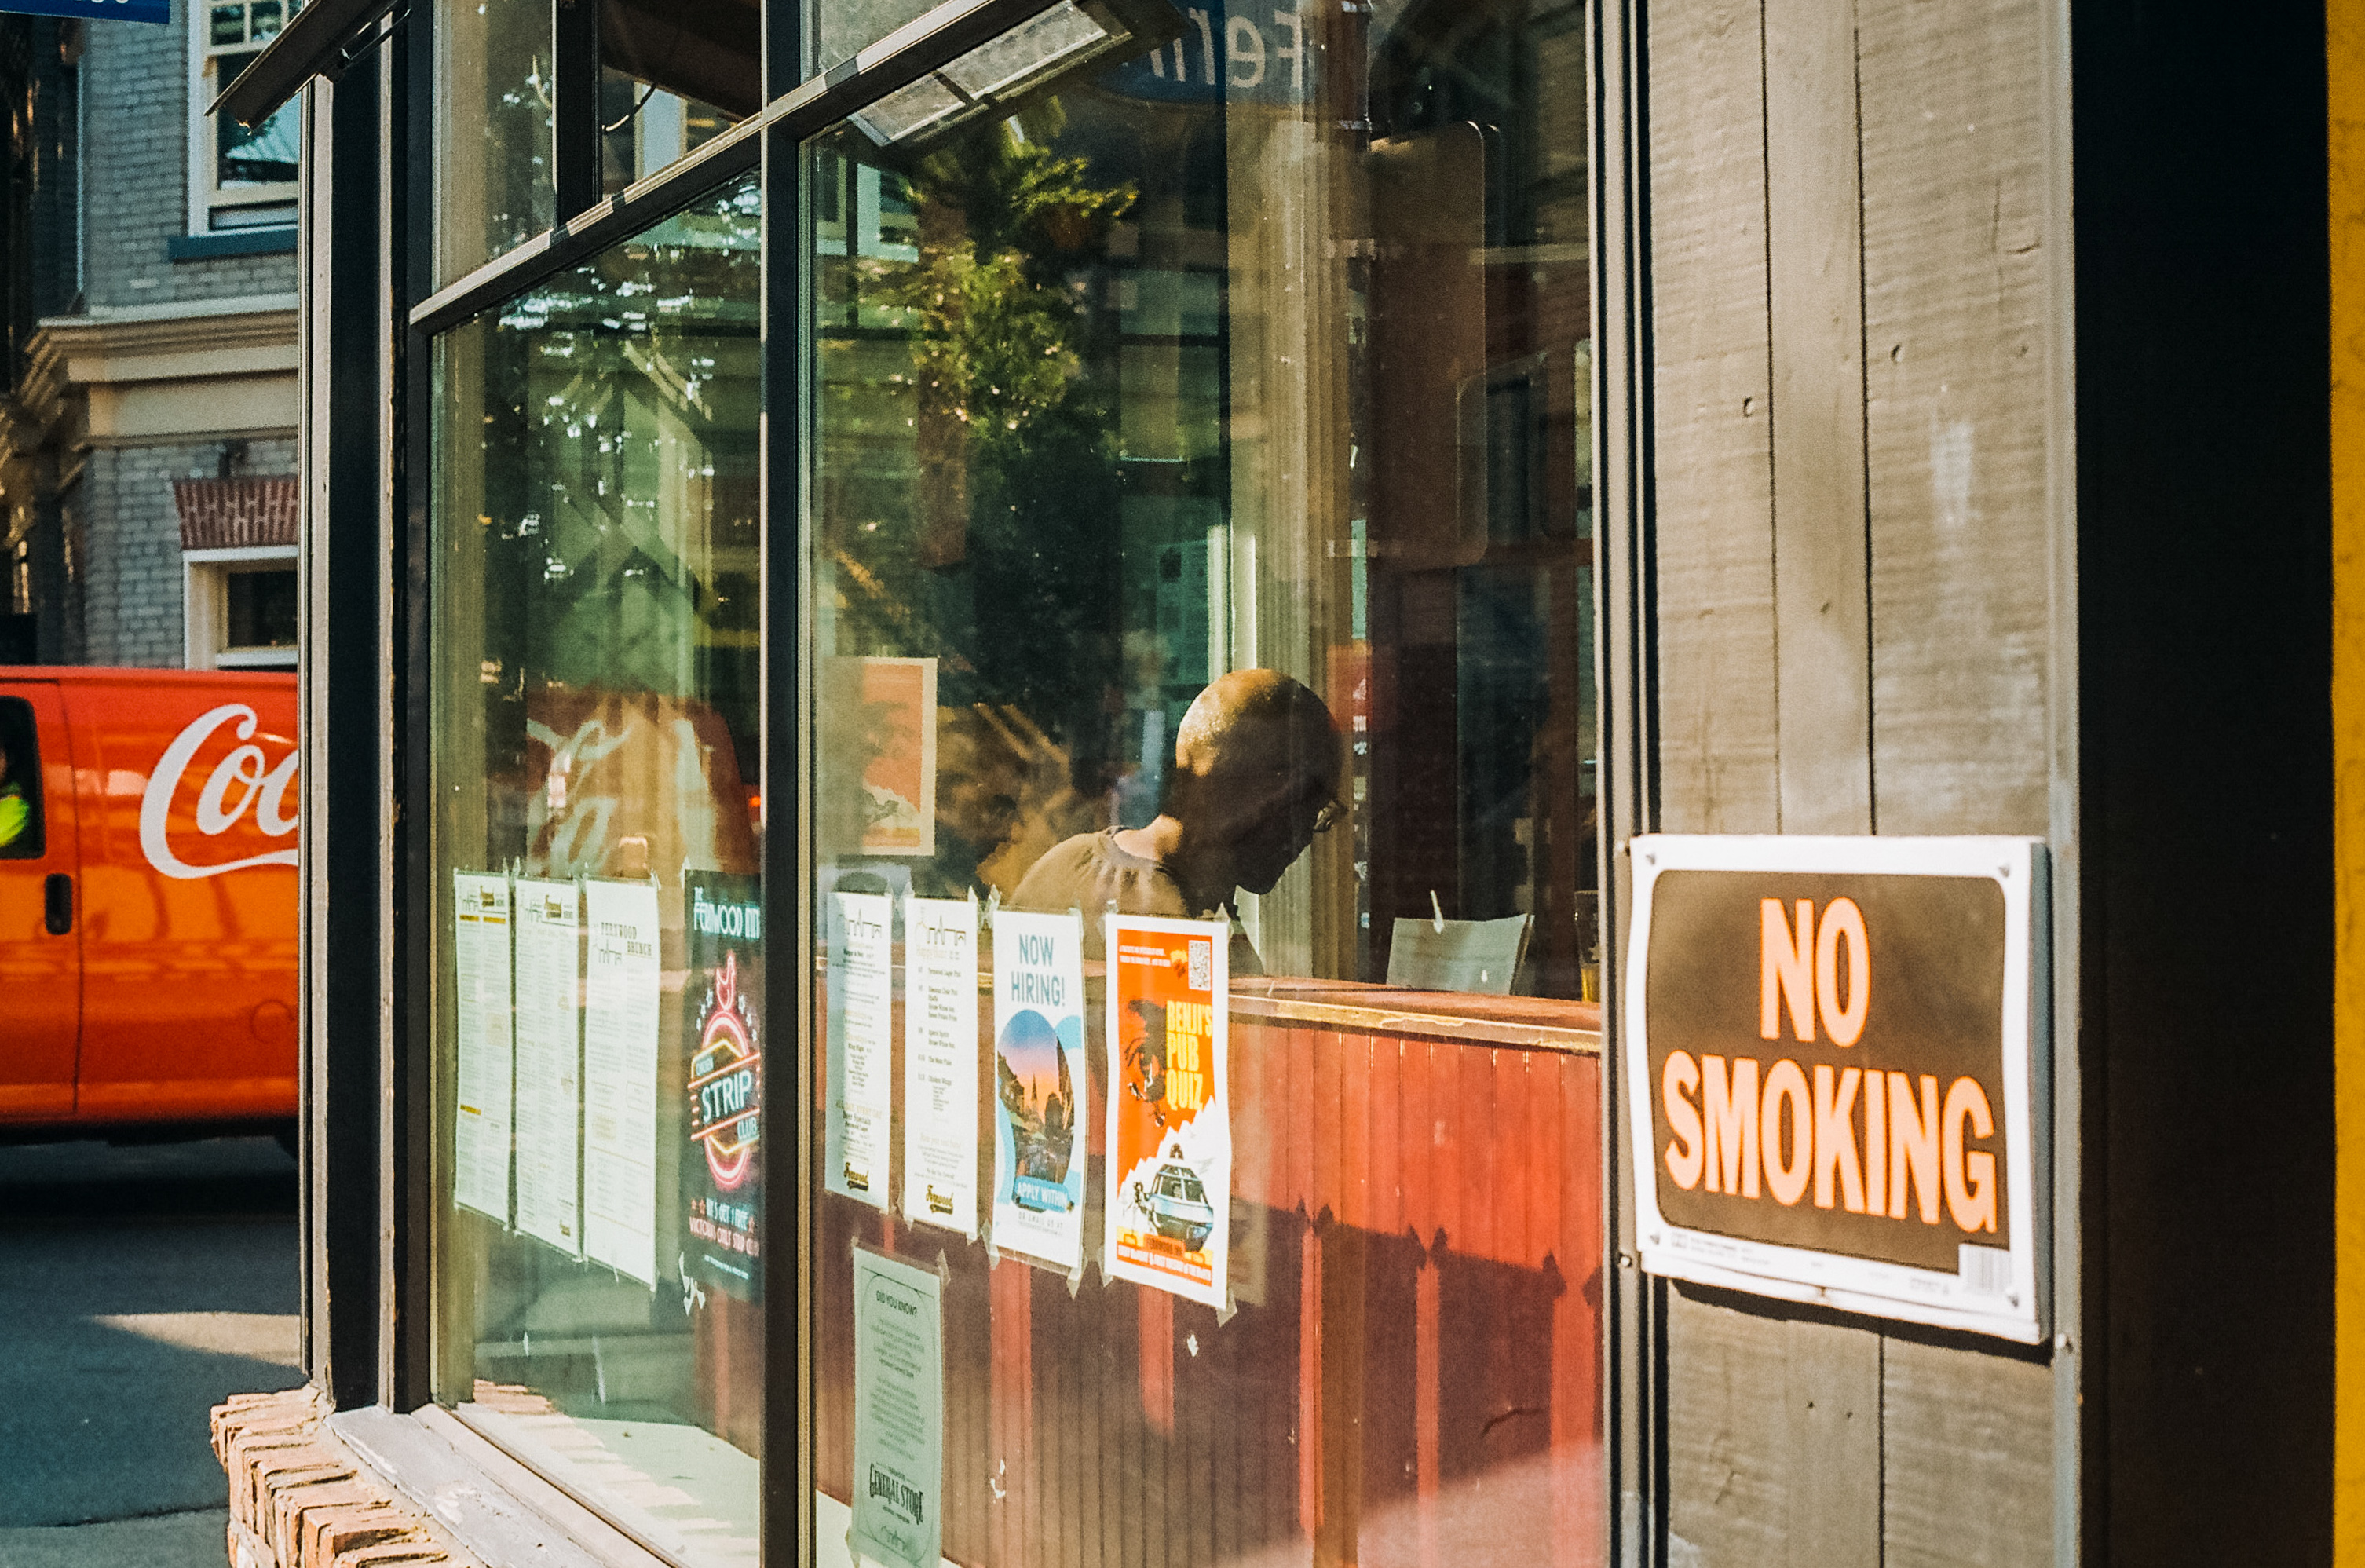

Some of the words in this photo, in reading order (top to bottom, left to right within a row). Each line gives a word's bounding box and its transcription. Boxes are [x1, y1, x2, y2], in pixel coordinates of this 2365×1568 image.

[601, 922, 638, 940] FERNWOOD
[627, 941, 652, 956] BRUNCH
[1018, 933, 1054, 967] NOW
[1011, 970, 1065, 1007] HIRING!
[1760, 896, 1871, 1047] NO
[1166, 1000, 1213, 1038] BENJI'S
[1166, 1031, 1200, 1072] PUB
[701, 1069, 752, 1124] STRIP
[1165, 1069, 1204, 1112] QUIZ
[1662, 1050, 1997, 1233] SMOKING
[926, 1184, 953, 1208] Fernwood
[1016, 1181, 1040, 1201] APPLY
[1040, 1186, 1068, 1208] WITHIN
[875, 1290, 886, 1304] DID
[886, 1295, 897, 1309] YOU
[897, 1300, 918, 1318] KNOW?
[869, 1462, 900, 1504] GENERAL
[901, 1484, 924, 1525] STORE
